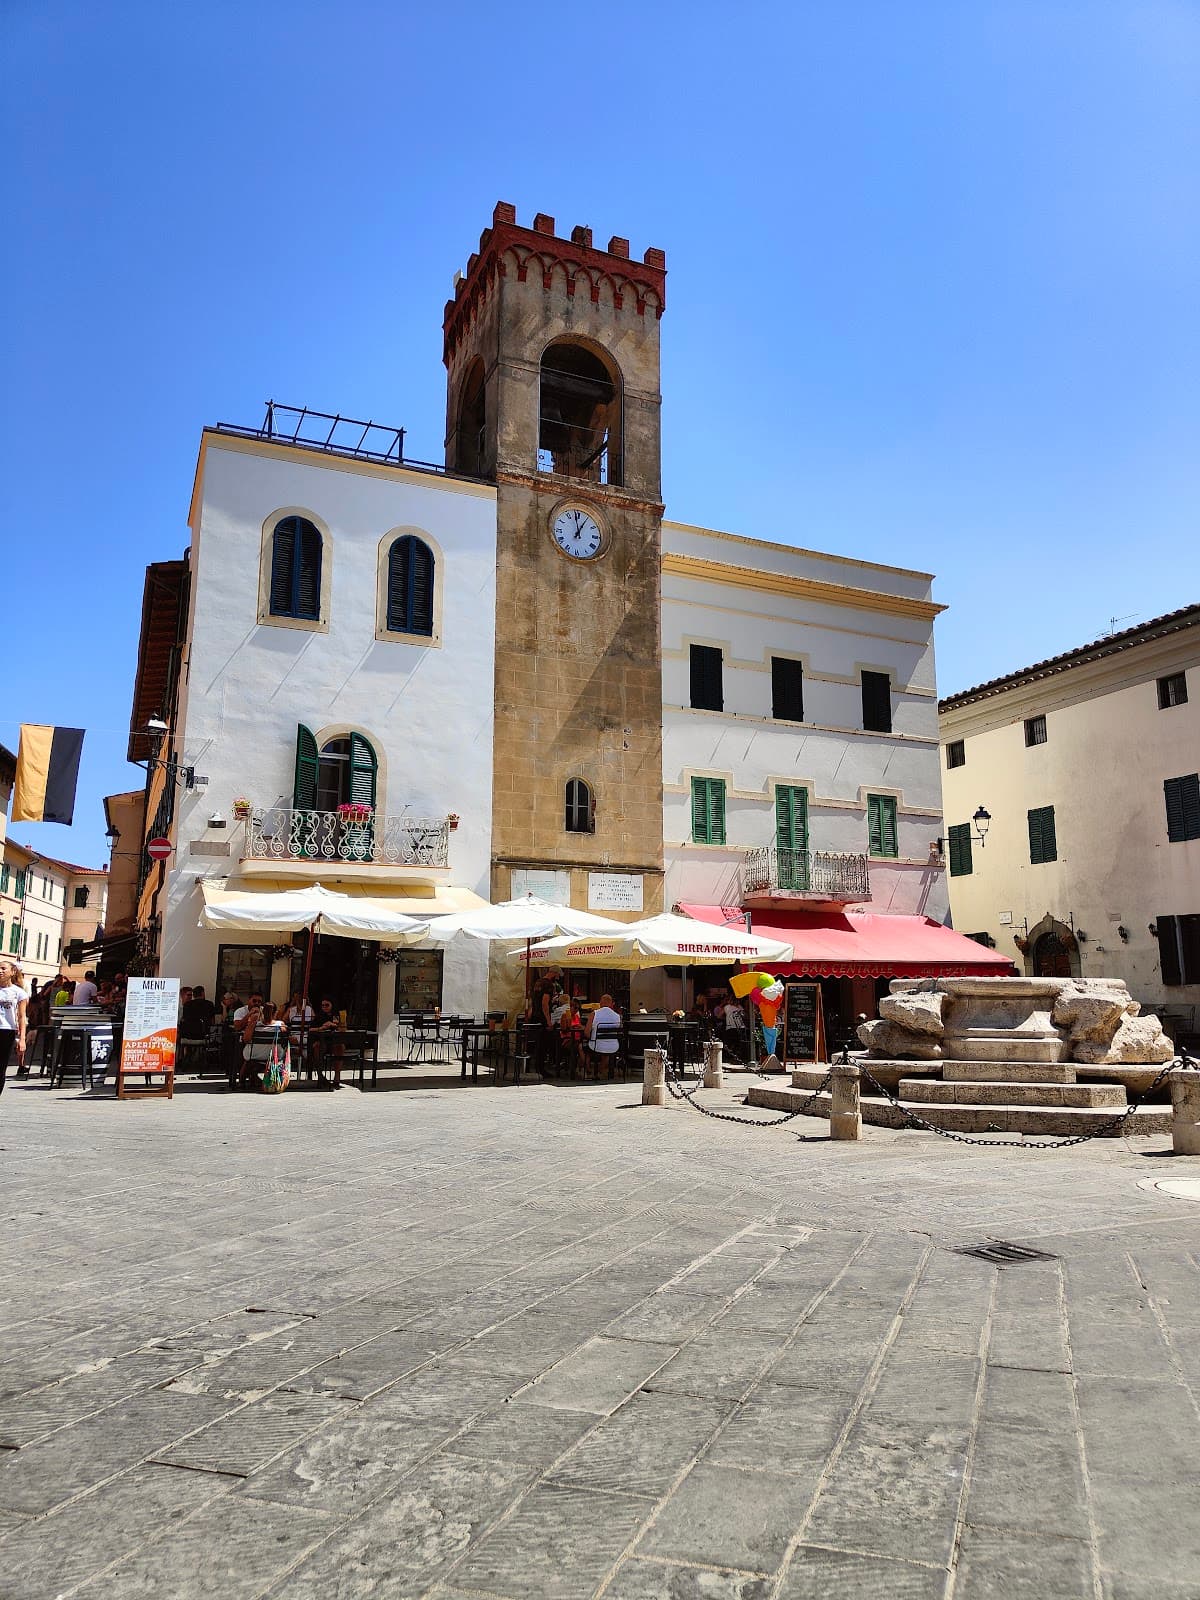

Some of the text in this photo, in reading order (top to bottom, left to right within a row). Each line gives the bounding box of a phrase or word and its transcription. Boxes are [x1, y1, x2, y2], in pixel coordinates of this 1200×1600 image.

[567, 945, 614, 956] BIRRA MORETTI
[677, 943, 758, 955] BIRRA MORETTI
[801, 963, 894, 974] BAR CENTRALE
[143, 980, 166, 990] MENU
